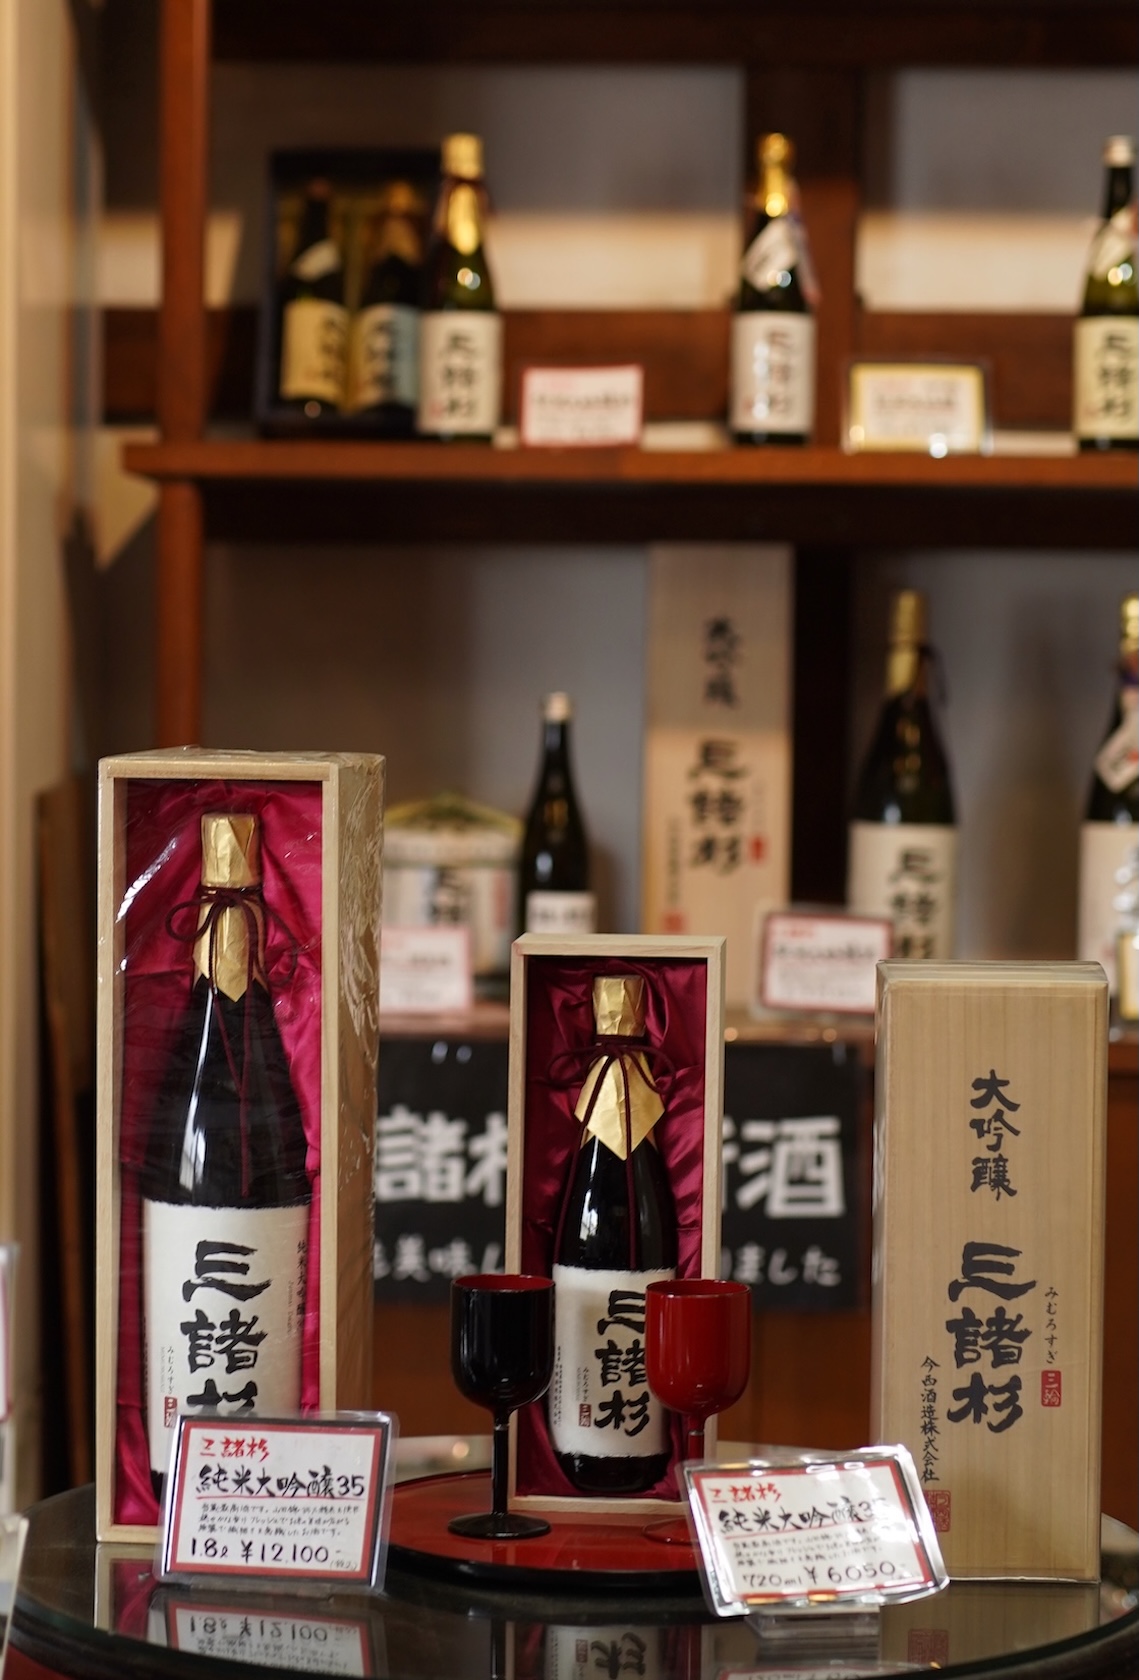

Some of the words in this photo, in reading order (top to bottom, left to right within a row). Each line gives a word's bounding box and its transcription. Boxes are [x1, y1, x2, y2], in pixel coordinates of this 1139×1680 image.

[969, 1069, 1021, 1201] 大吟醸
[945, 1242, 1036, 1433] 三諸杉
[1044, 1286, 1059, 1364] みむろすぎ
[200, 1436, 270, 1462] 三諸杉
[920, 1355, 941, 1483] 今西酒造株式会社
[195, 1463, 365, 1499] 純米大吟醸35
[718, 1496, 887, 1534] 純米大吟醸3
